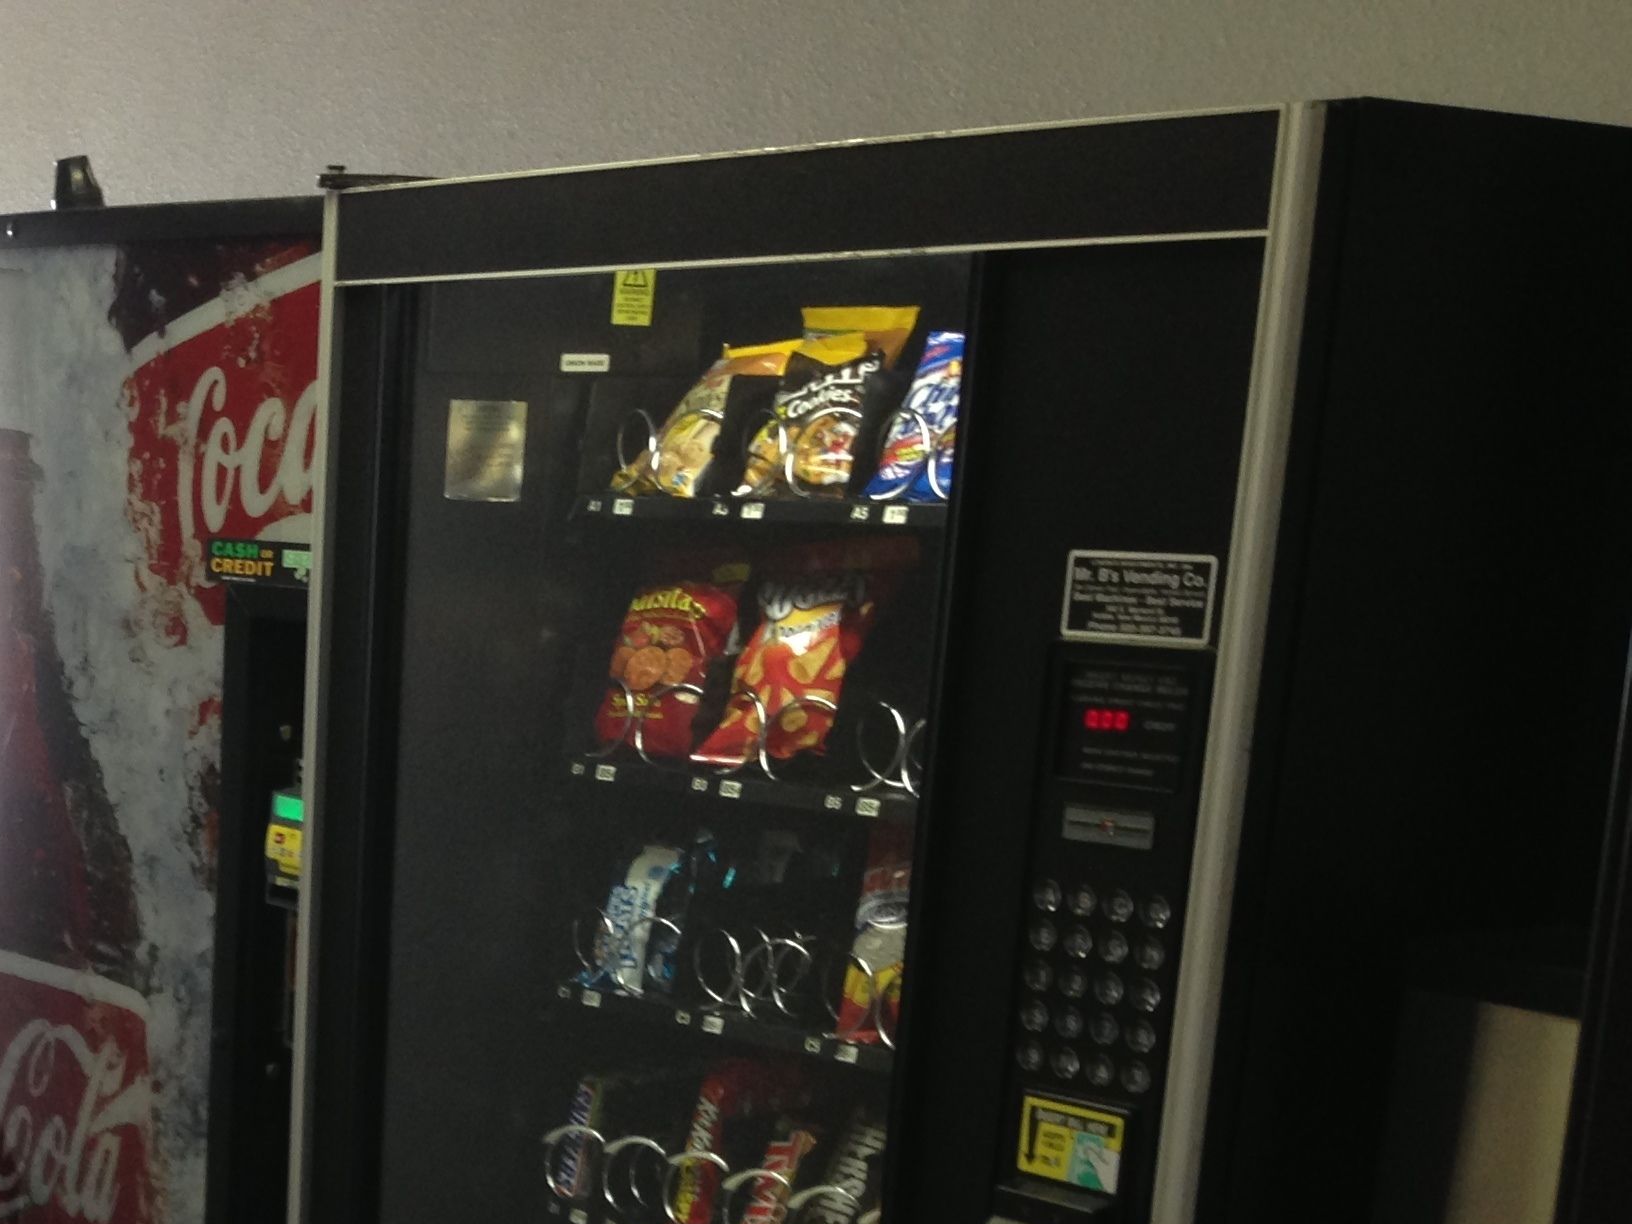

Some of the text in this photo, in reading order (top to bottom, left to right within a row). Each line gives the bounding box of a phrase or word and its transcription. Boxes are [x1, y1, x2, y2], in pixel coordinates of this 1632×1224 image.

[211, 541, 259, 559] CASH
[210, 557, 274, 576] CREDIT
[1122, 569, 1180, 589] Vending
